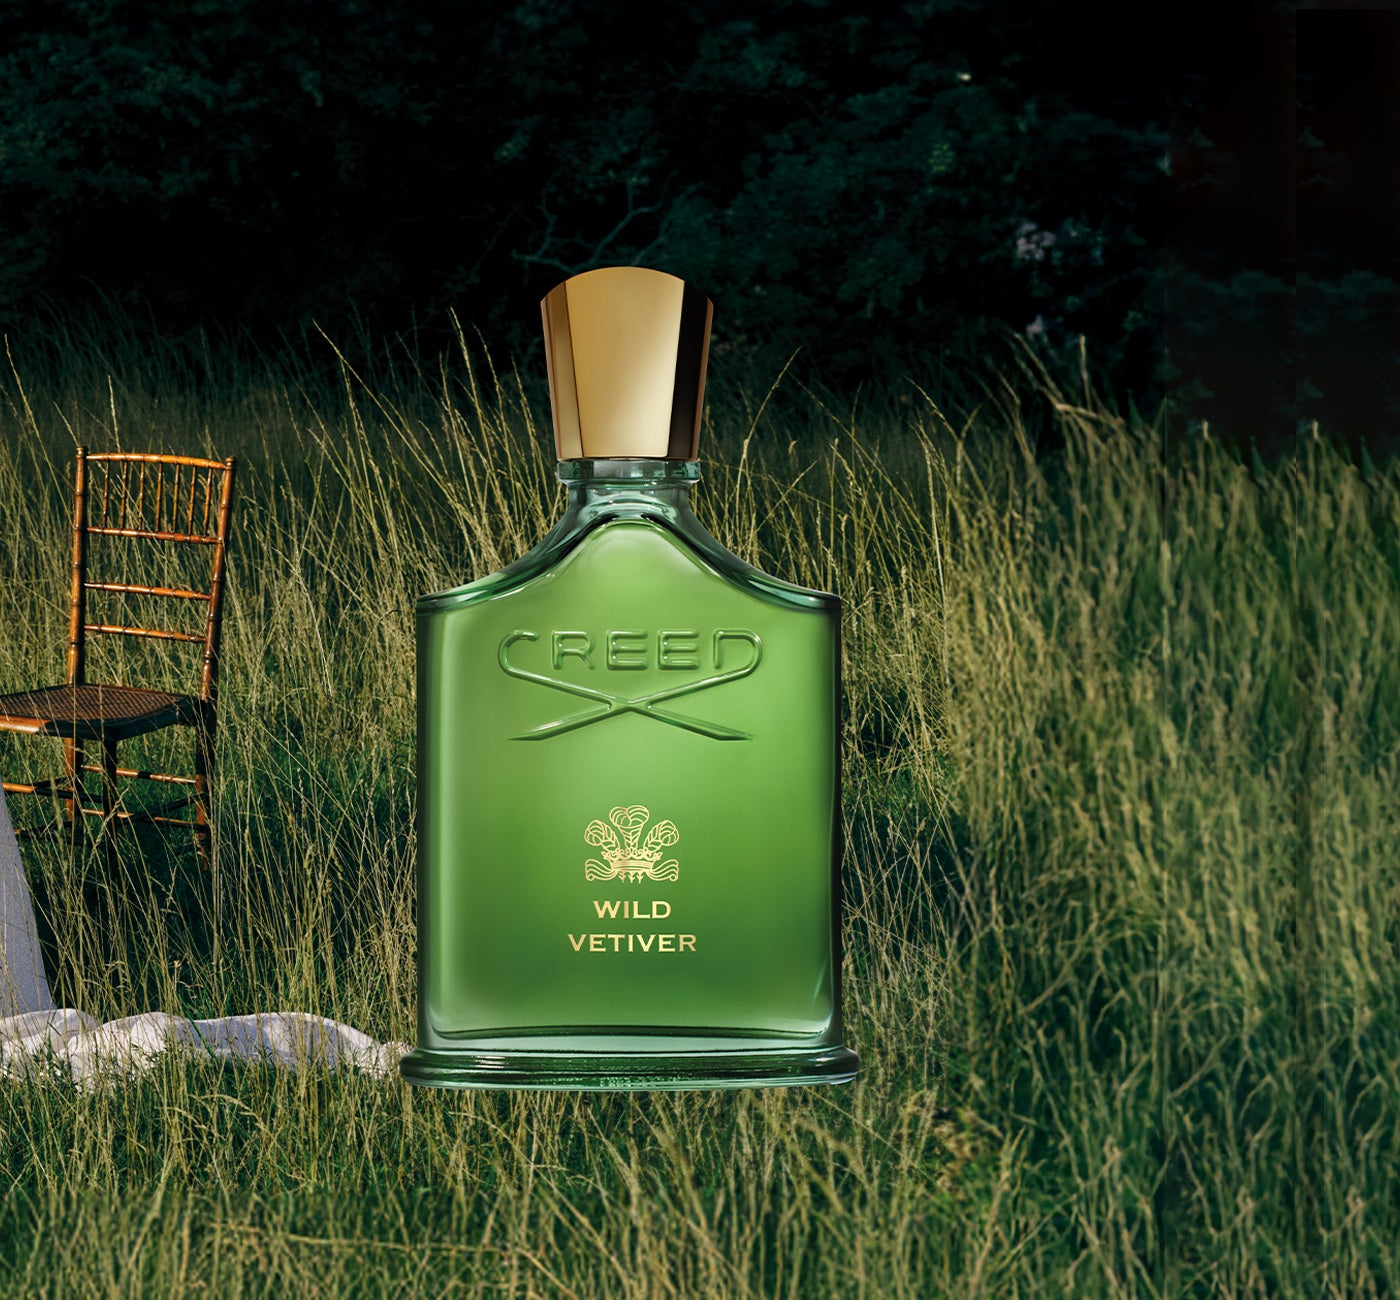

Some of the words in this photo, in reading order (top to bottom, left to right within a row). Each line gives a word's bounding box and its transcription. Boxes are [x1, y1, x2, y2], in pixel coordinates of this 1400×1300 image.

[497, 627, 764, 676] CREED
[592, 900, 672, 919] WILD
[567, 933, 697, 953] VETIVER
